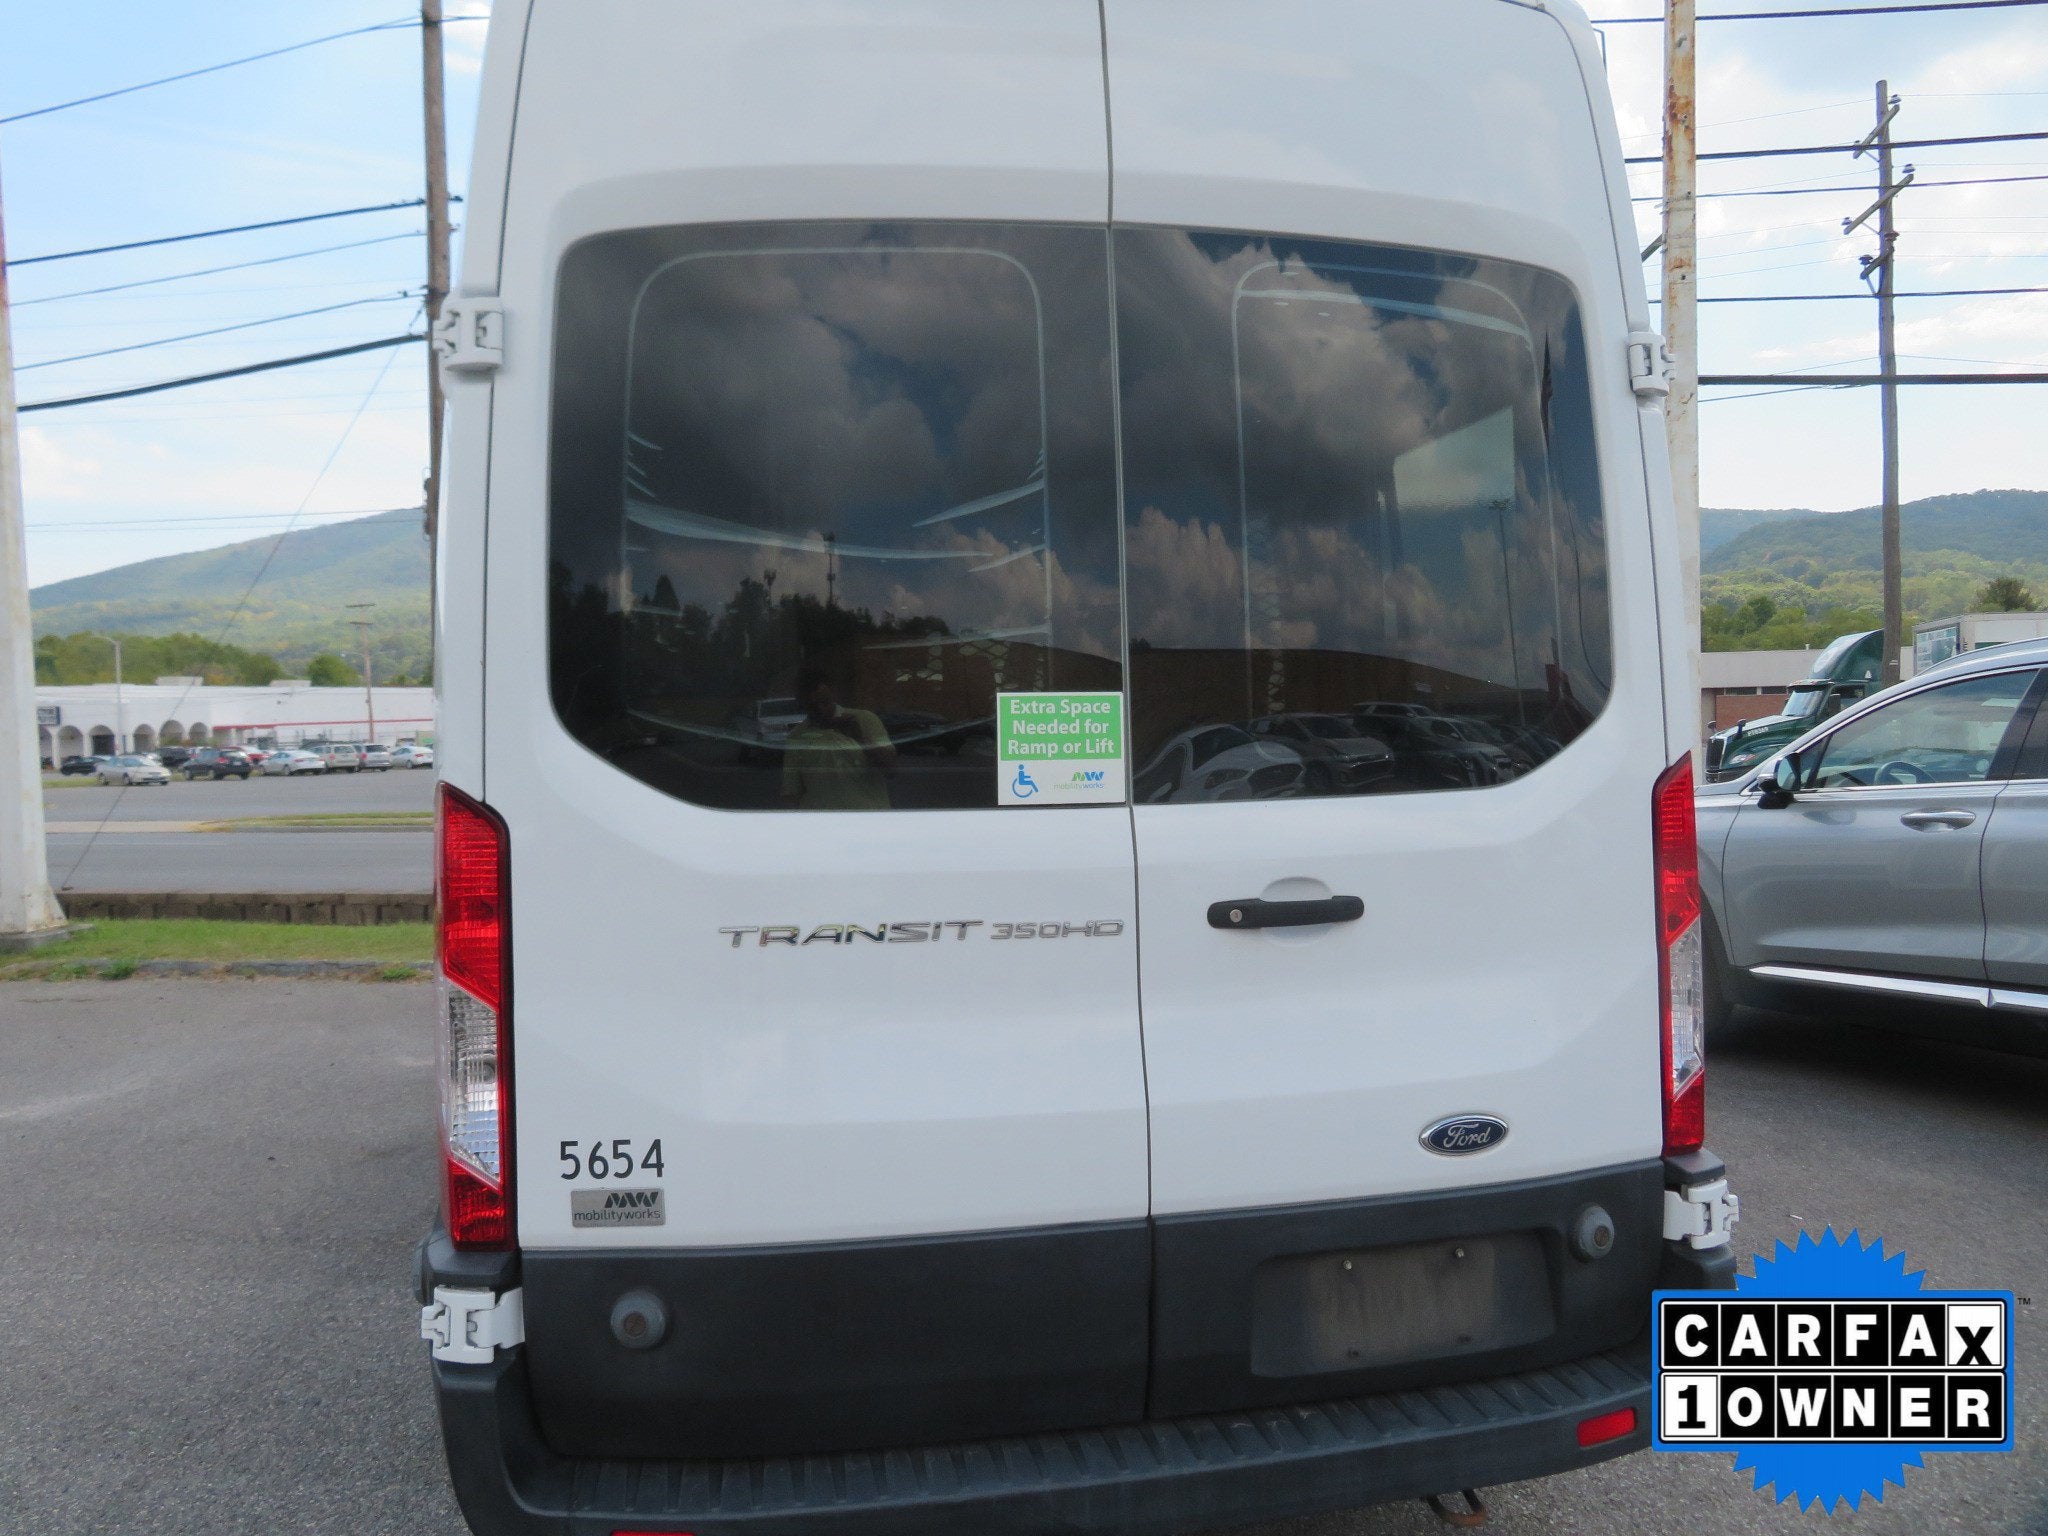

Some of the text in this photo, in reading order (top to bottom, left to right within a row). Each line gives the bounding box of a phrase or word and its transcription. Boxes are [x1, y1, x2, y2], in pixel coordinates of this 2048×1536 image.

[1010, 699, 1111, 717] Extra Space
[1013, 718, 1110, 734] Needed for
[1008, 738, 1115, 757] Ramp or Lift
[719, 919, 1124, 947] TRANSIT 350HD
[1443, 1123, 1491, 1148] Ford
[560, 1139, 665, 1180] 5654
[574, 1208, 661, 1222] mobilityworks
